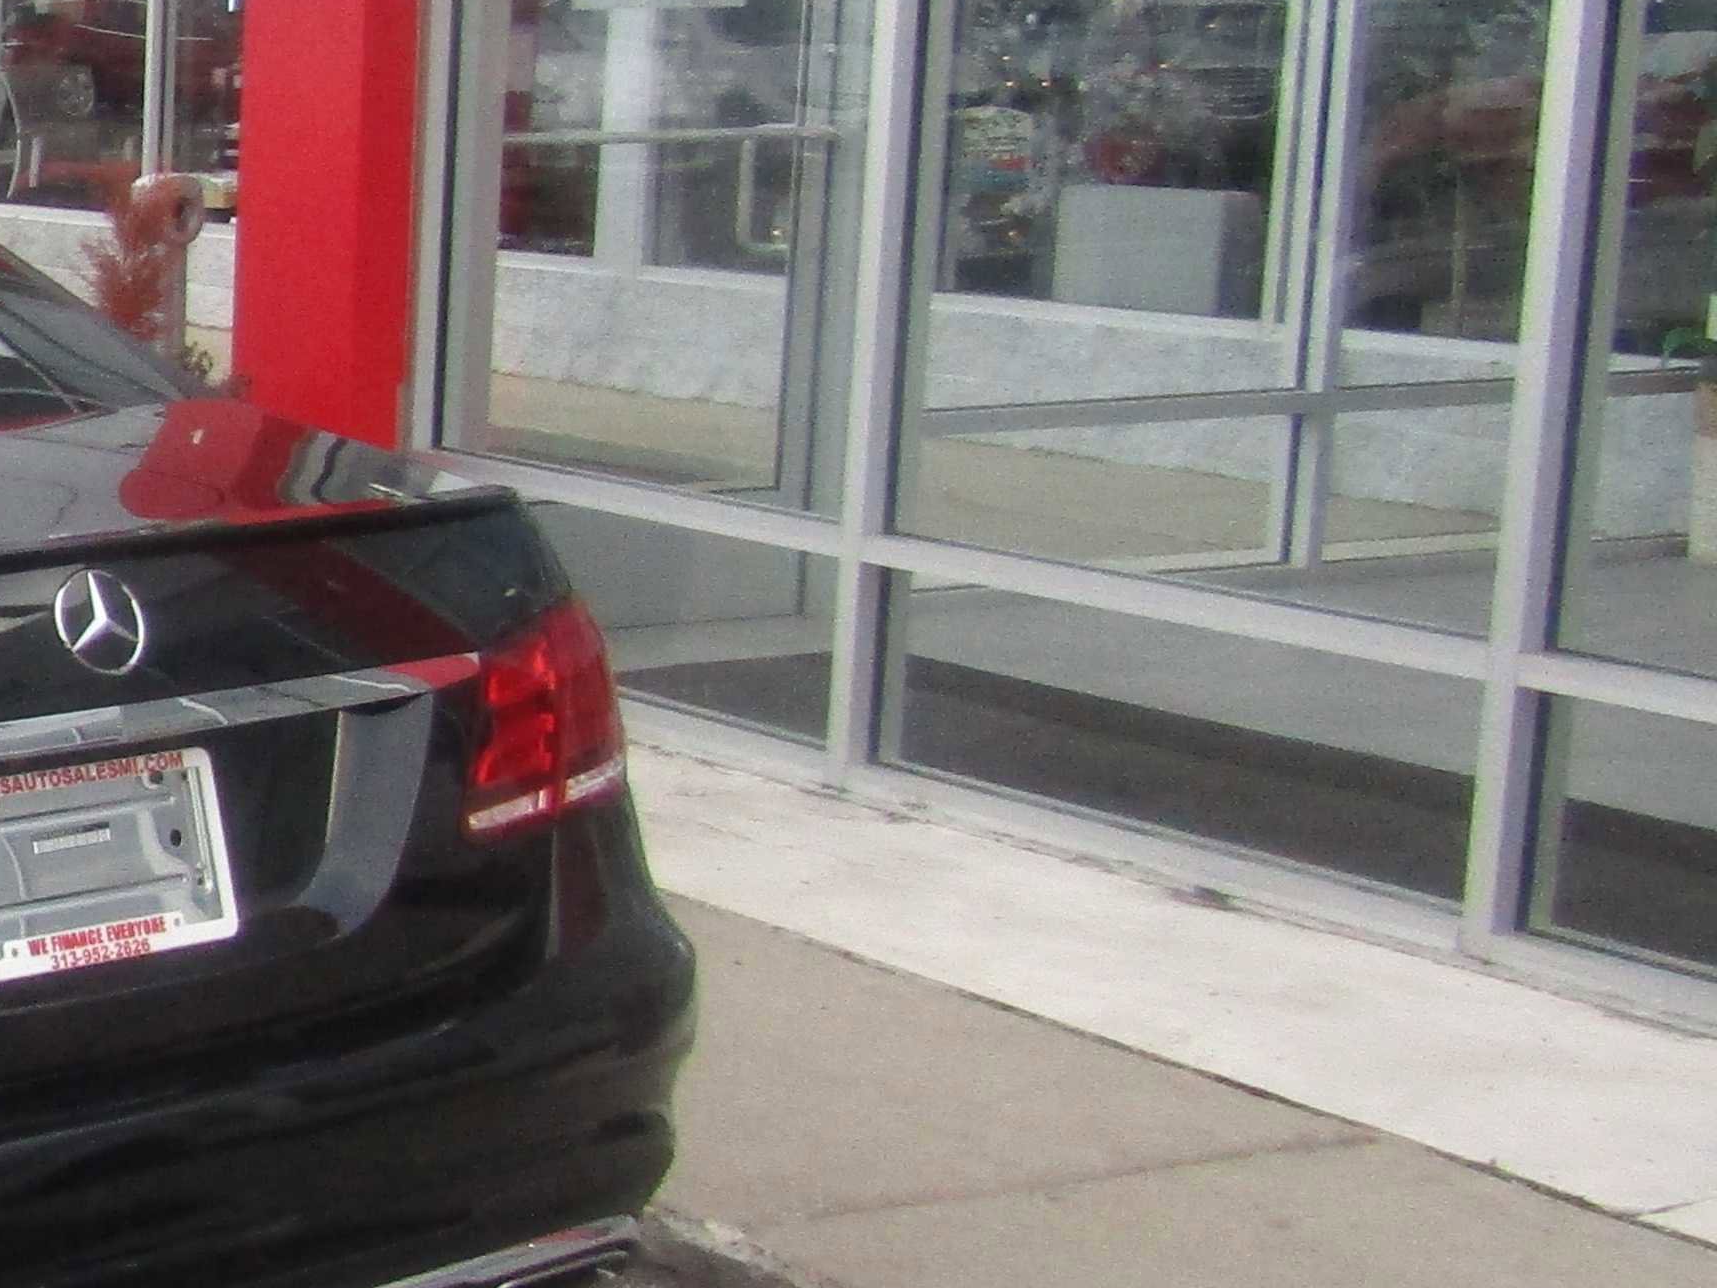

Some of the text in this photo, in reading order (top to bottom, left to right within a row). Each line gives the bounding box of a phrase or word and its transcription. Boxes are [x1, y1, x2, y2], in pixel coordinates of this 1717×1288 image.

[27, 916, 166, 956] WE FINANCE EVERYONE
